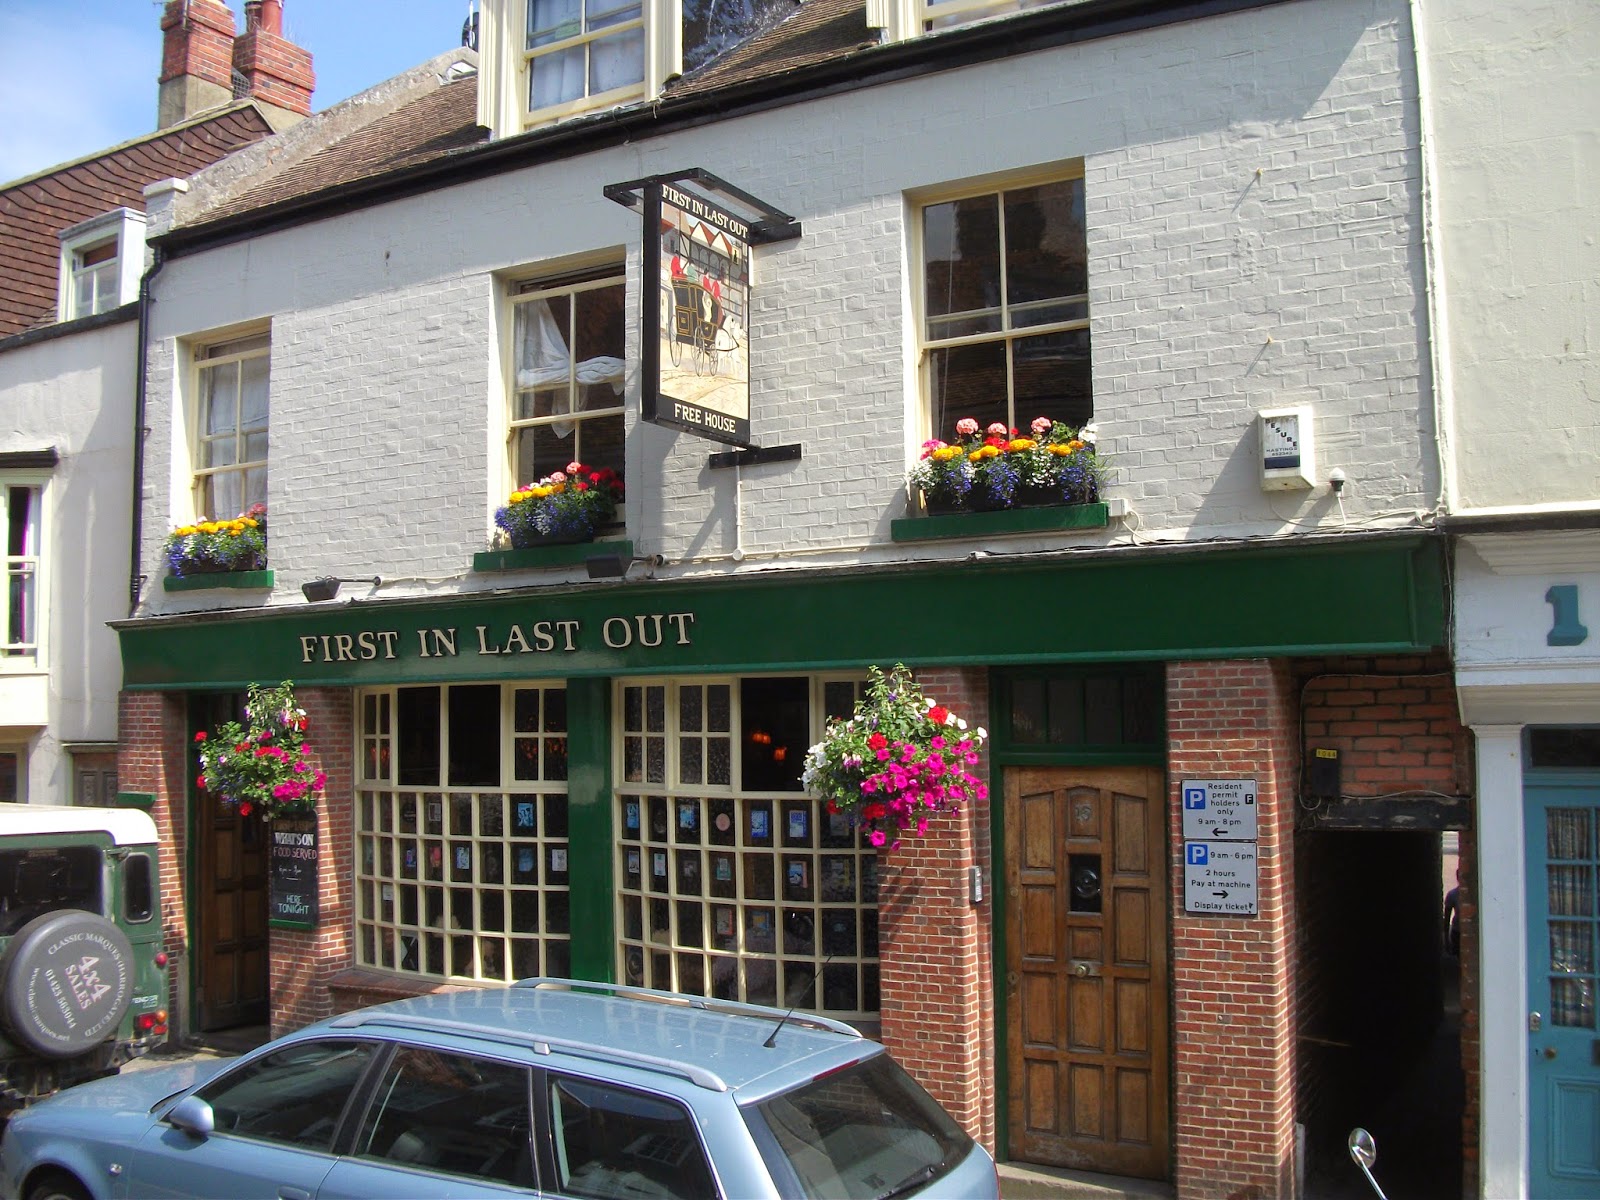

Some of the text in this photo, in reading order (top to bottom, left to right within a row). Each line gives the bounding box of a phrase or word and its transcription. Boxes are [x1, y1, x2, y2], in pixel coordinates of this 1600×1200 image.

[661, 183, 748, 239] FIRST IN LAST OUT
[674, 402, 736, 434] FREE HOUSE
[1545, 584, 1588, 647] 1
[300, 611, 695, 663] FIRST IN LAST OUT
[1208, 782, 1243, 790] Resident
[1189, 790, 1203, 808] P
[1212, 791, 1238, 800] permit
[1246, 794, 1253, 803] F
[1210, 799, 1240, 807] holders
[1217, 808, 1234, 816] only
[274, 832, 314, 846] WHAT'S ON
[273, 846, 318, 860] FOOD SERVED
[1192, 846, 1206, 863] P
[1213, 869, 1236, 877] hours
[1191, 879, 1251, 889] Pay at machine
[286, 894, 302, 905] HERE
[1194, 901, 1248, 911] Display ticket
[278, 903, 310, 915] TONIGHT
[47, 932, 84, 955] CLASSIC
[85, 932, 122, 961] MARQUES
[45, 968, 63, 997] 01423
[78, 955, 112, 1003] 4x4
[64, 964, 93, 1010] SALES
[84, 1024, 103, 1037] LTD
